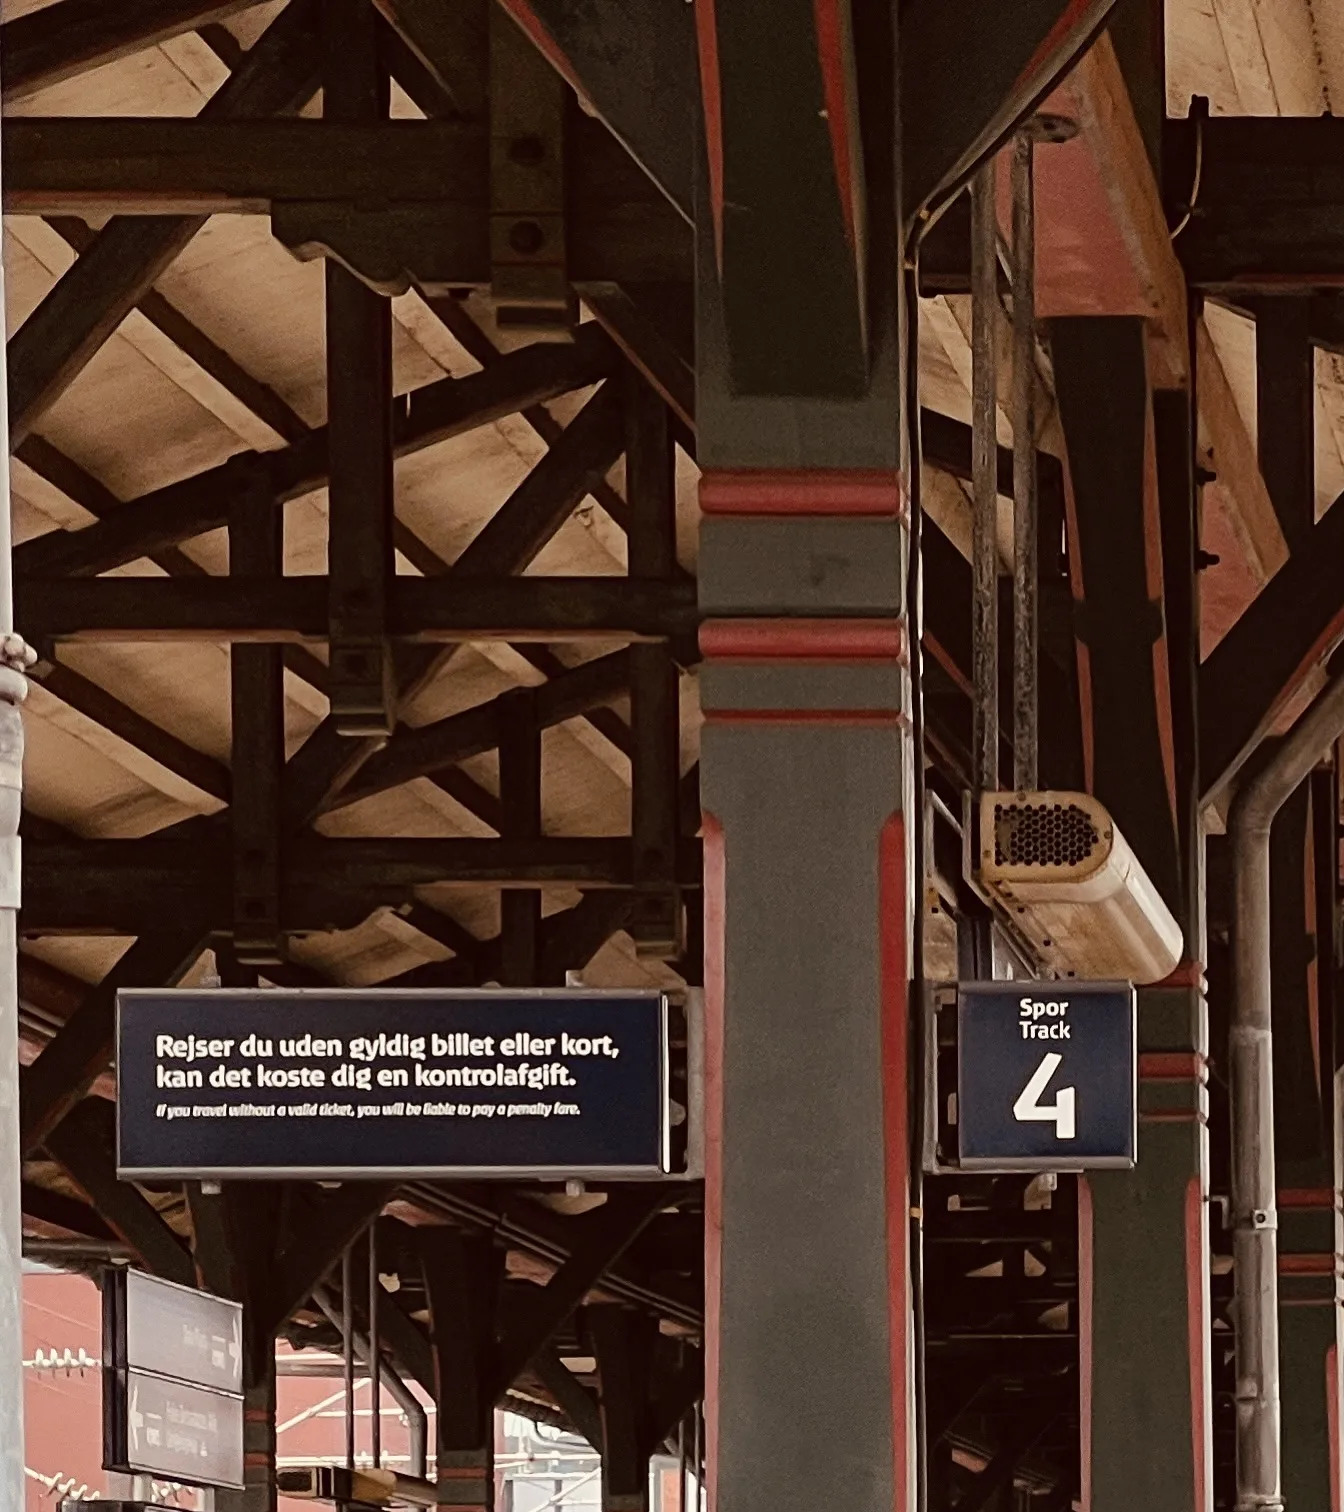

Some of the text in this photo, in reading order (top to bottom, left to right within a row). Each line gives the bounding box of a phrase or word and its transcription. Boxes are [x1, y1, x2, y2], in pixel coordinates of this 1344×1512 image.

[1019, 998, 1069, 1021] Spor
[1019, 1020, 1071, 1039] Track
[156, 1032, 619, 1062] Rejser du uden gyldig billet eller kort,
[156, 1062, 577, 1091] kan det koste dig en kontrolafgift.
[1013, 1052, 1076, 1139] 4
[167, 1105, 191, 1121] you
[192, 1103, 227, 1117] travel
[228, 1103, 275, 1117] without
[276, 1106, 286, 1117] a
[288, 1103, 318, 1117] valid
[319, 1102, 355, 1118] ticket,
[357, 1104, 381, 1119] you
[382, 1102, 404, 1116] will
[405, 1102, 422, 1116] be
[422, 1102, 456, 1116] liable
[457, 1103, 471, 1116] to
[471, 1104, 496, 1118] pay
[496, 1104, 506, 1116] a
[507, 1102, 552, 1118] penalty
[553, 1101, 581, 1115] fare.
